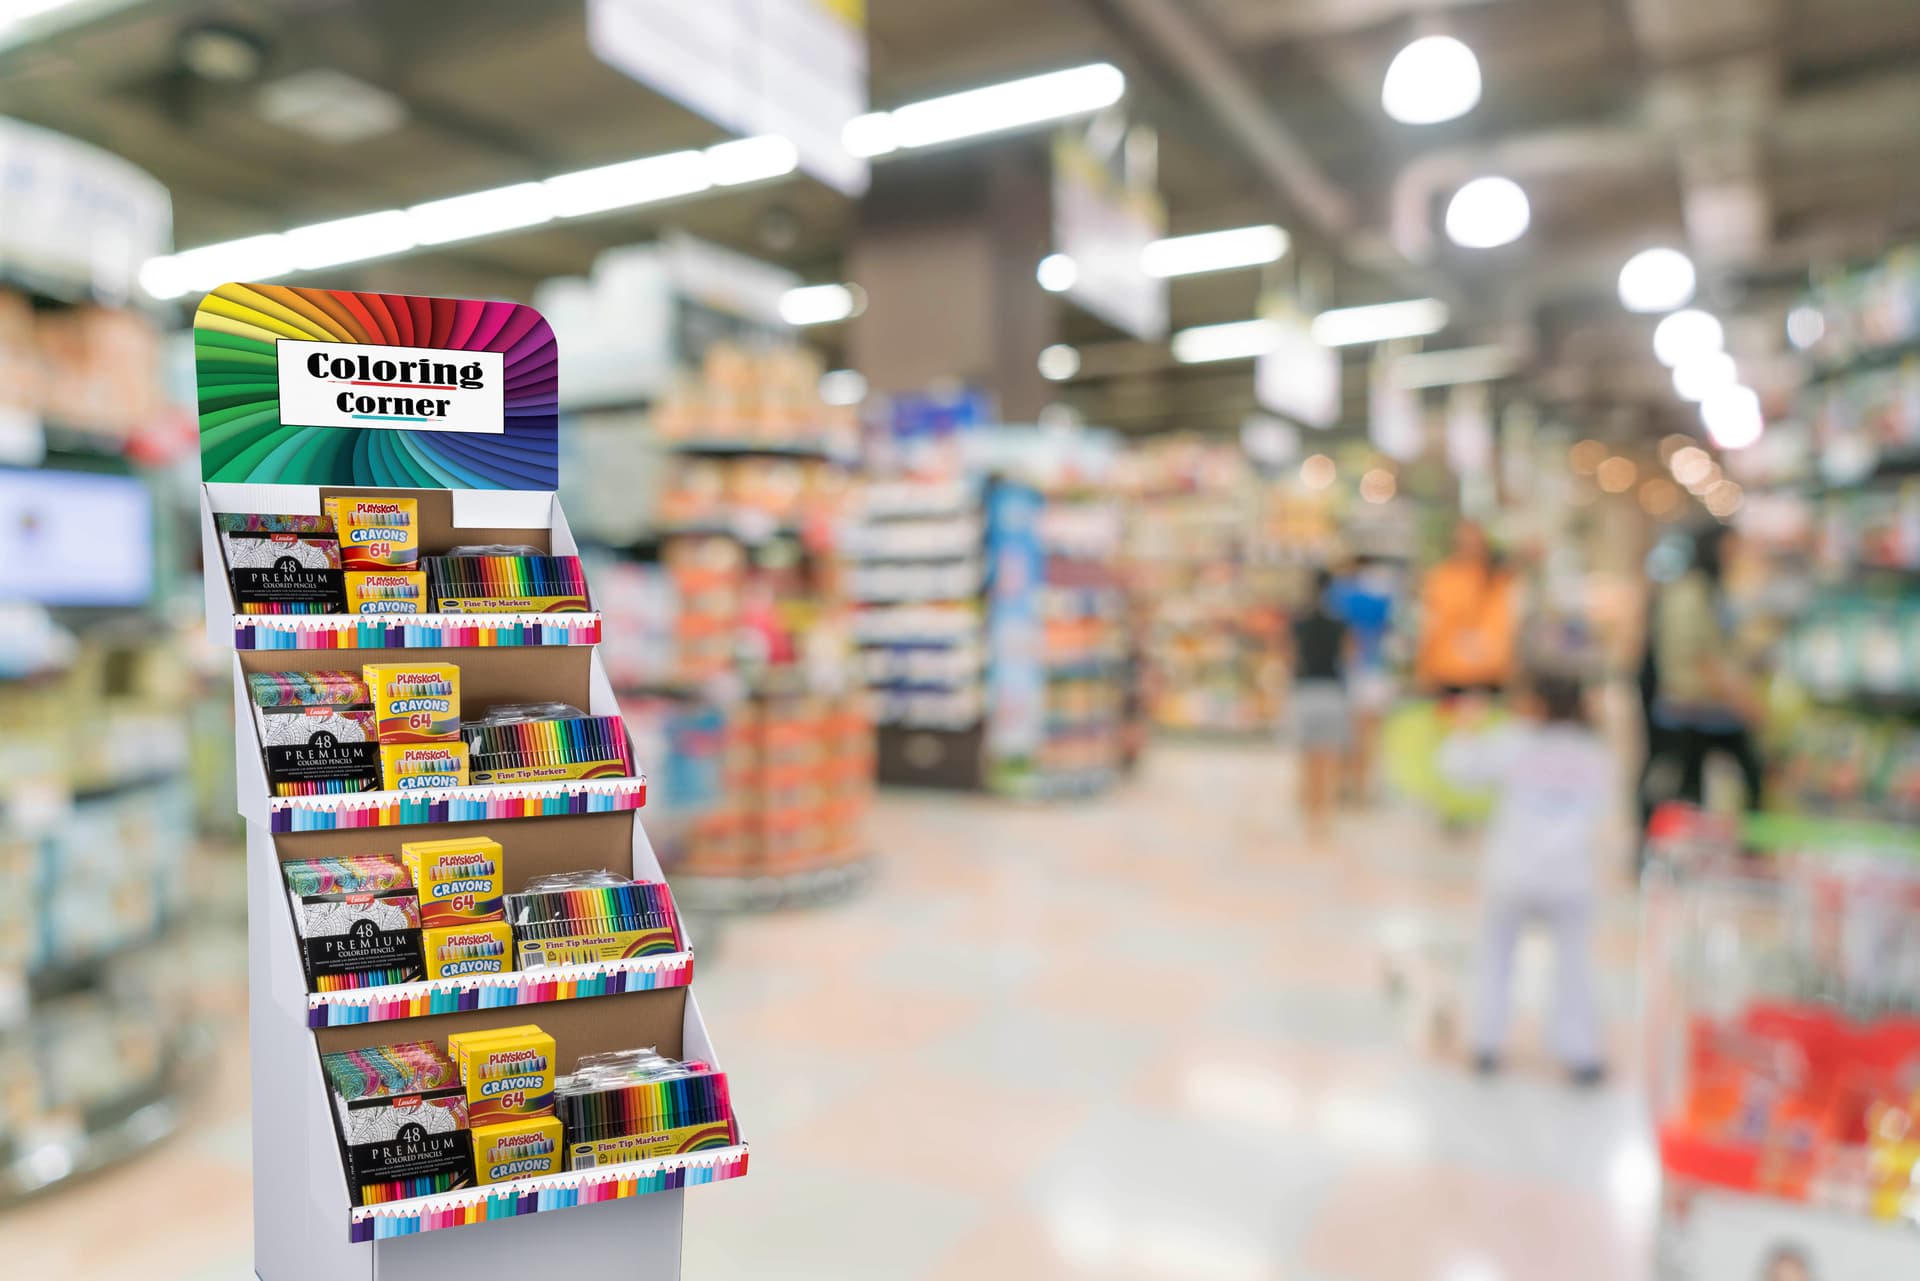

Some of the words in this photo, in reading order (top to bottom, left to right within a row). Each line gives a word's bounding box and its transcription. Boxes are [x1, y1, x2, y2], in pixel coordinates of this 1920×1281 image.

[307, 352, 484, 390] Coloring
[336, 391, 451, 417] Corner
[357, 503, 401, 514] PLAYSKOOL
[350, 527, 408, 543] CRAYONS
[369, 542, 391, 558] 64
[279, 560, 297, 573] 48
[251, 573, 328, 583] PREMIUM
[366, 576, 410, 587] PLAYSKOOL
[360, 600, 417, 614] CRAYONS
[483, 600, 497, 608] Tip
[498, 599, 531, 607] Markers
[396, 673, 443, 685] PLAYSKOOL
[390, 698, 450, 714] CRAYONS
[409, 713, 432, 730] 64
[314, 735, 332, 749] 48
[285, 748, 364, 761] PREMIUM
[405, 749, 452, 761] PLAYSKOOL
[297, 759, 328, 767] COLORED
[496, 771, 516, 780] Fine
[518, 770, 532, 779] Tip
[533, 767, 567, 777] Markers
[398, 774, 459, 790] CRAYONS
[439, 853, 485, 868] PLAYSKOOL
[432, 879, 493, 898] CRAYONS
[451, 894, 475, 912] 64
[355, 923, 374, 938] 48
[325, 935, 407, 952] PREMIUM
[447, 933, 495, 948] PLAYSKOOL
[545, 941, 564, 950] Fine
[566, 940, 580, 948] Tip
[582, 936, 616, 946] Markers
[338, 949, 370, 958] COLORED
[370, 946, 395, 954] PENCILS
[440, 959, 502, 978] CRAYONS
[489, 1048, 537, 1066] PLAYSKOOL
[481, 1075, 545, 1097] CRAYONS
[500, 1091, 526, 1110] 64
[402, 1126, 421, 1143] 48
[497, 1131, 545, 1150] PLAYSKOOL
[371, 1137, 455, 1160] PREMIUM
[597, 1142, 617, 1152] Fine
[618, 1139, 633, 1149] Tip
[635, 1134, 670, 1146] Markers
[384, 1154, 417, 1166] COLORED
[417, 1150, 443, 1160] PENCILS
[489, 1158, 552, 1179] CRAYONS
